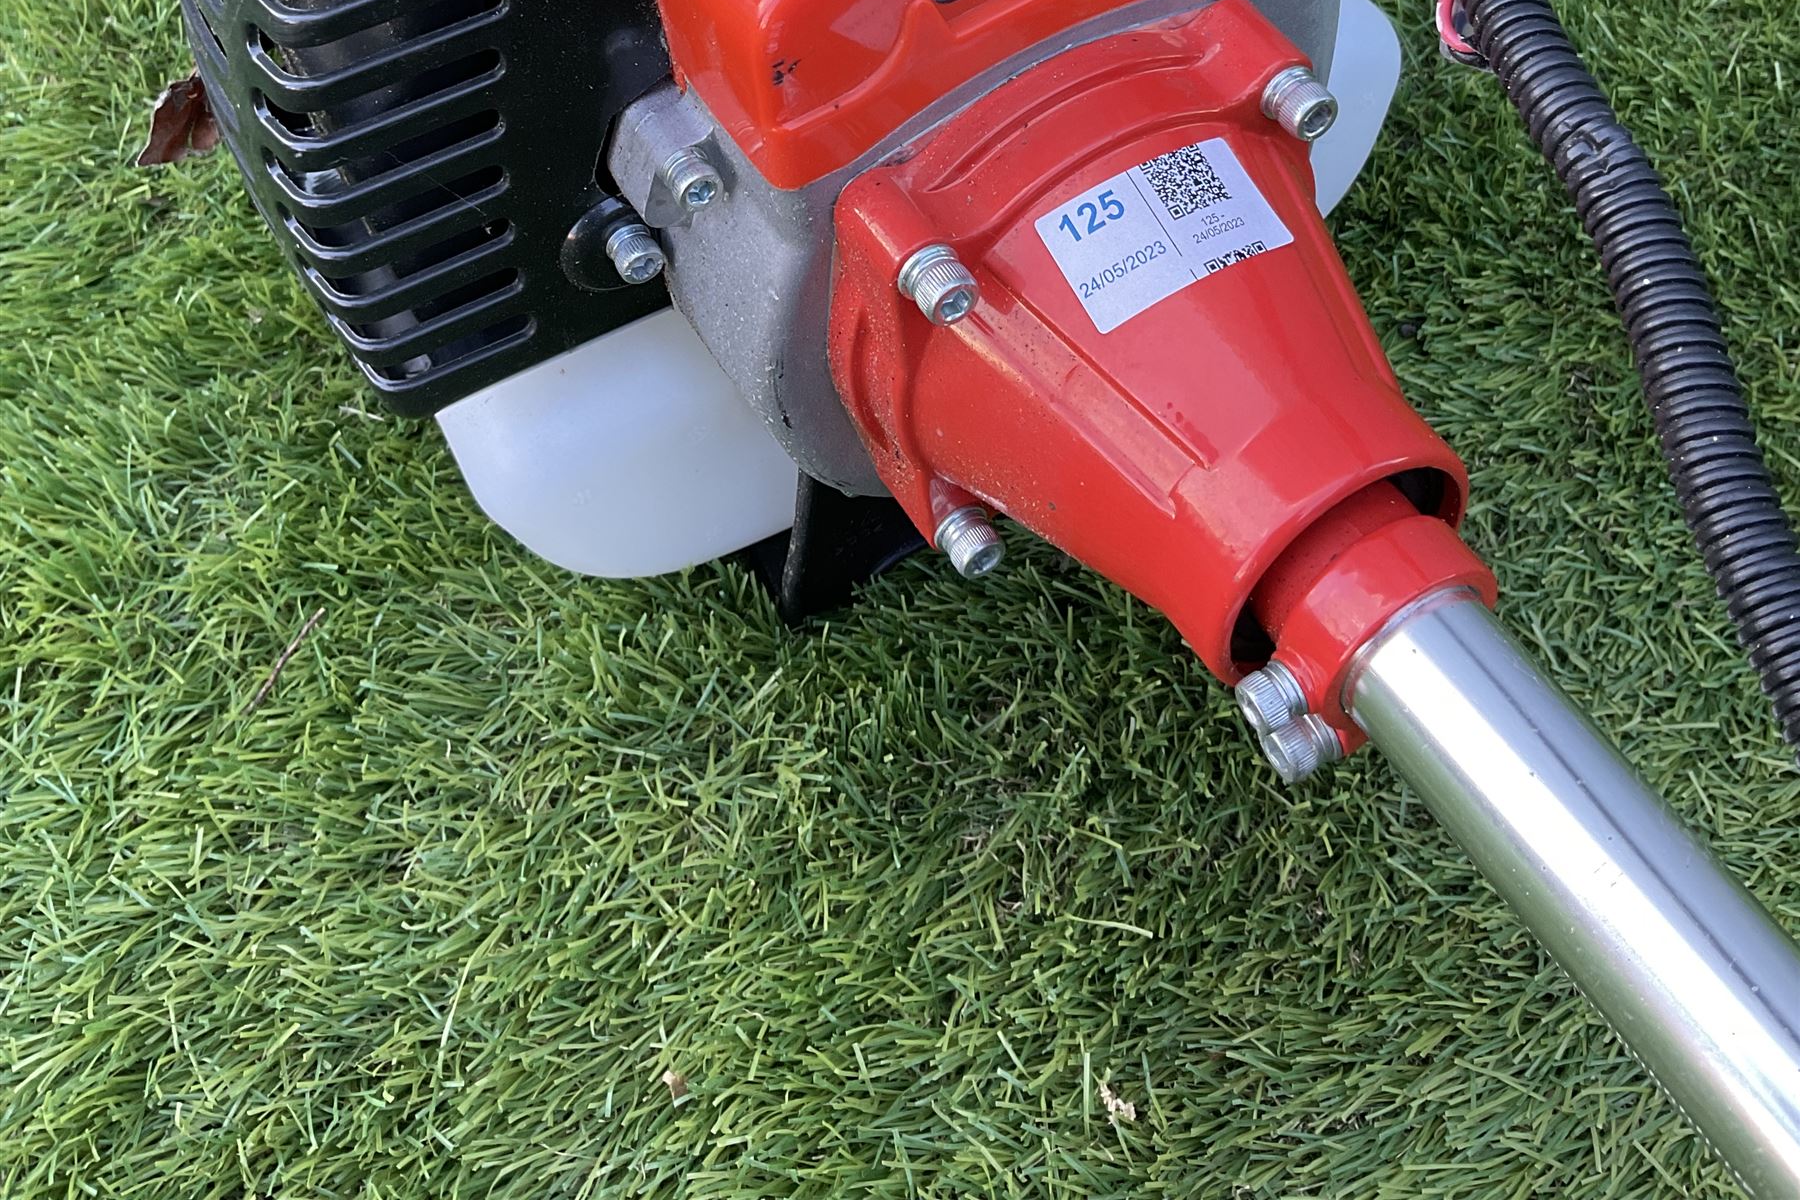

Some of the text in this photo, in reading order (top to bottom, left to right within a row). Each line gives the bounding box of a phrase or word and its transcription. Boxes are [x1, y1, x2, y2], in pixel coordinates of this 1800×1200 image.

[1058, 189, 1125, 242] 125
[1192, 216, 1245, 244] 24/05/2023
[1079, 240, 1167, 299] 24/05/2023
